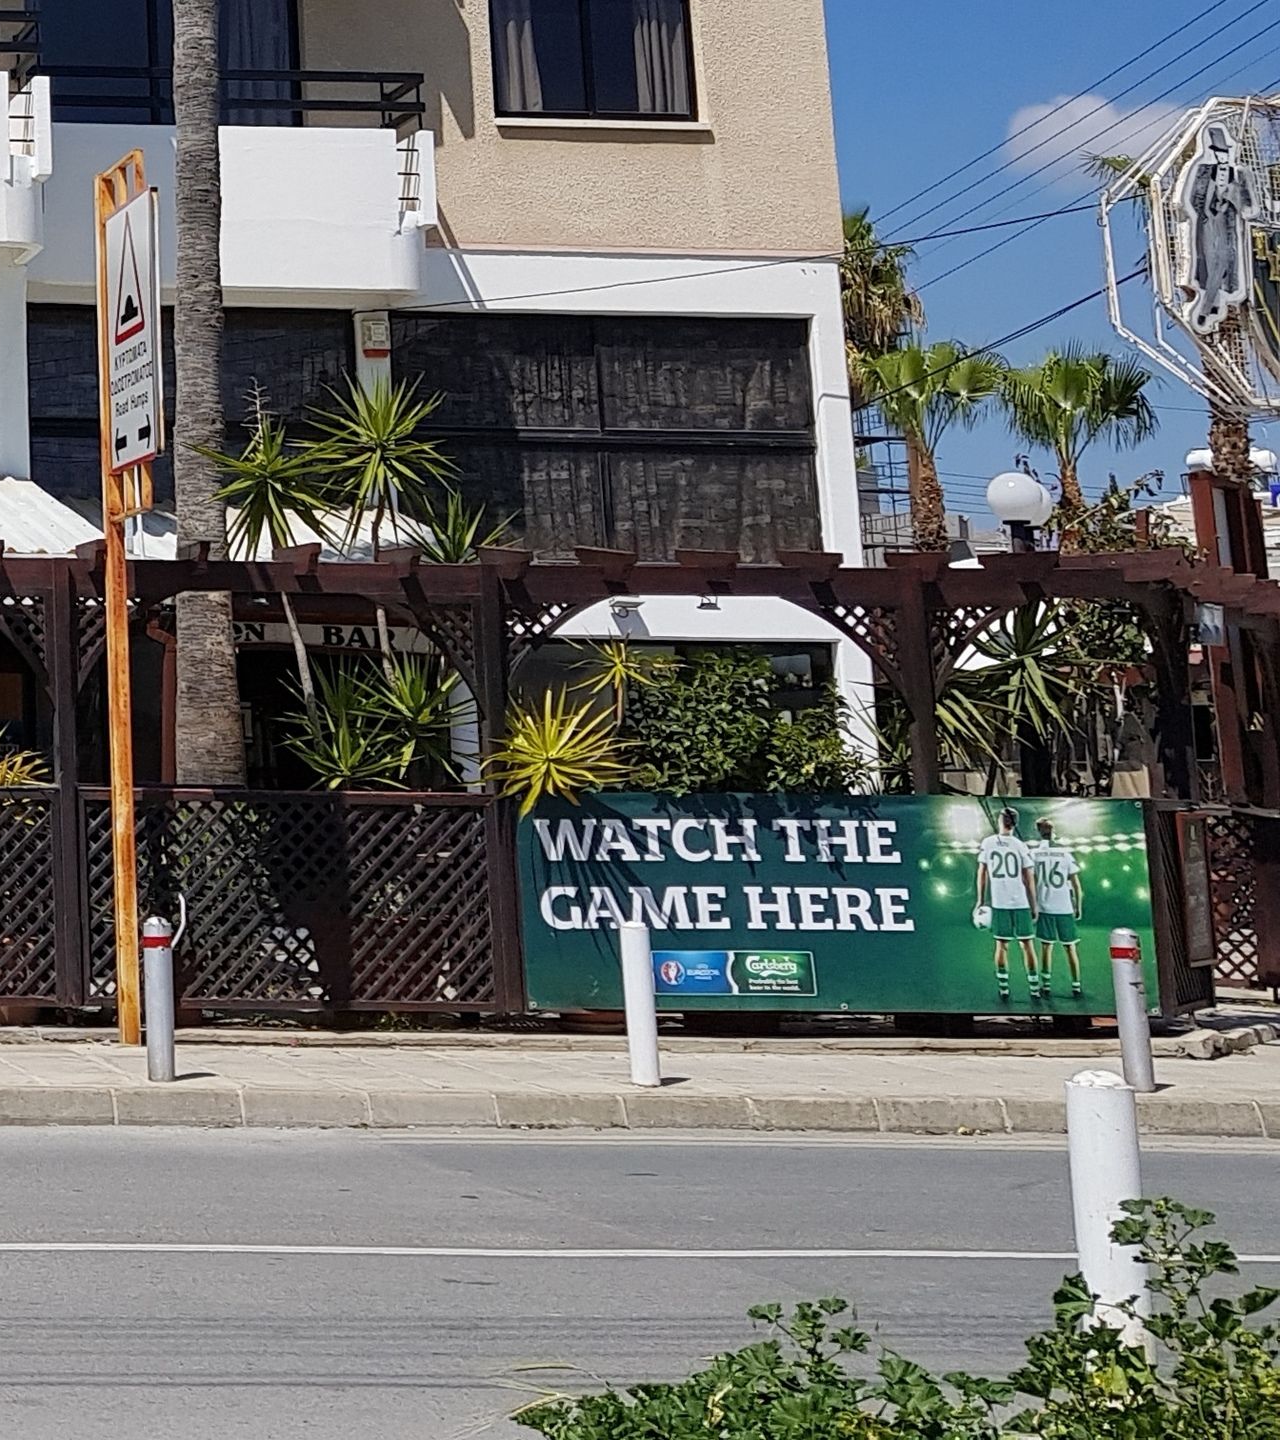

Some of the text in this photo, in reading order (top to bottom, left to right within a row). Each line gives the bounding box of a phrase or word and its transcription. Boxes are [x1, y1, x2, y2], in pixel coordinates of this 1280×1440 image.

[322, 625, 397, 651] BAR
[532, 817, 903, 864] WATCH THE
[990, 850, 1019, 879] 20
[1039, 860, 1065, 889] 16
[539, 885, 915, 932] GAME HERE
[745, 955, 798, 976] Carlsberg
